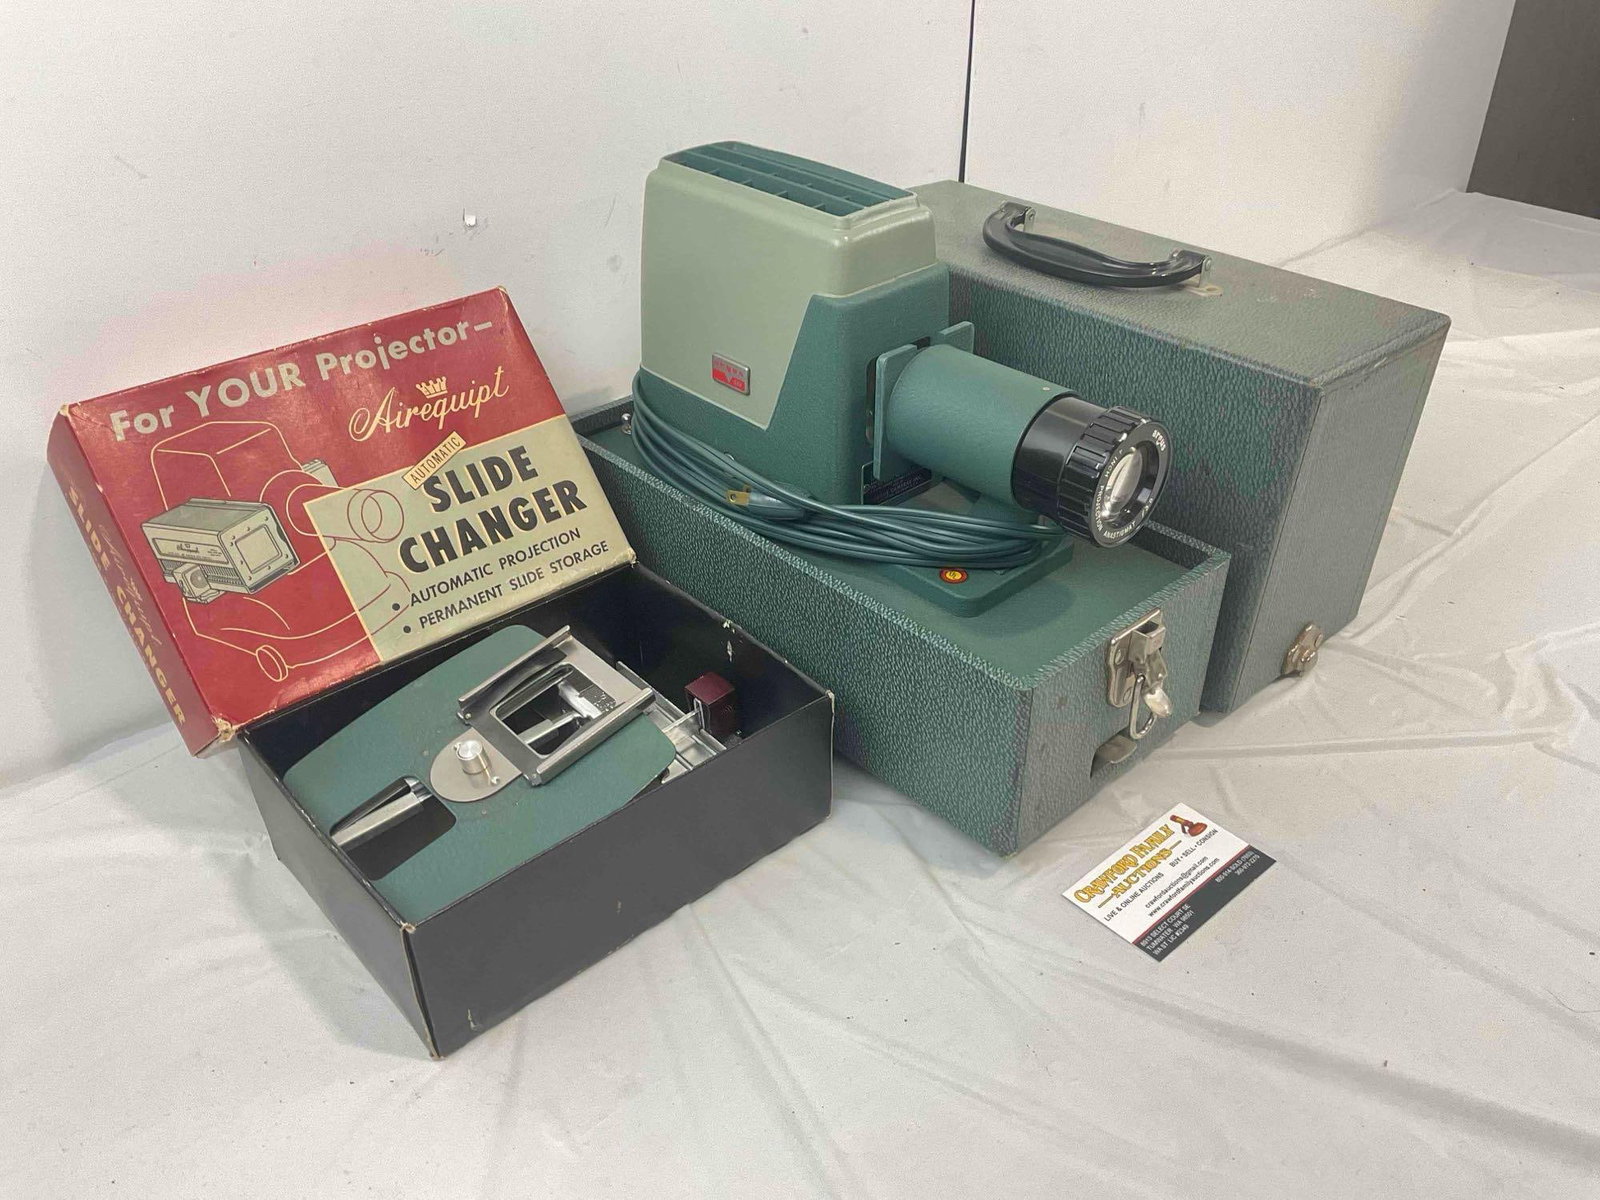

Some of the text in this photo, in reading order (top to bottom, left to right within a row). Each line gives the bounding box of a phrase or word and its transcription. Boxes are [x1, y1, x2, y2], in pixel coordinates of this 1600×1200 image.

[109, 404, 174, 441] For
[185, 362, 306, 418] YOUR
[348, 366, 510, 442] Airequipt
[409, 436, 462, 483] AUTOMATIC
[422, 445, 538, 513] SLIDE
[1104, 456, 1118, 478] INCH
[398, 479, 587, 574] CHANGER
[410, 527, 581, 607] AUTOMATIC PROJECTION
[419, 540, 609, 629] PERMANENT SLIDE STORAGE
[67, 485, 111, 571] SLIDE
[115, 584, 187, 725] CHANGER
[1073, 824, 1175, 903] CRAWFORD FAMILY
[1112, 848, 1173, 898] AUCTIONS
[1169, 829, 1218, 867] BUY SELL CONSIGN
[1104, 908, 1118, 922] LIVE
[1121, 892, 1141, 910] ONLINE
[1140, 873, 1164, 895] AUCTIONS
[1145, 856, 1208, 909] crawfordauctions@gmail.com
[1166, 908, 1183, 924] COURT
